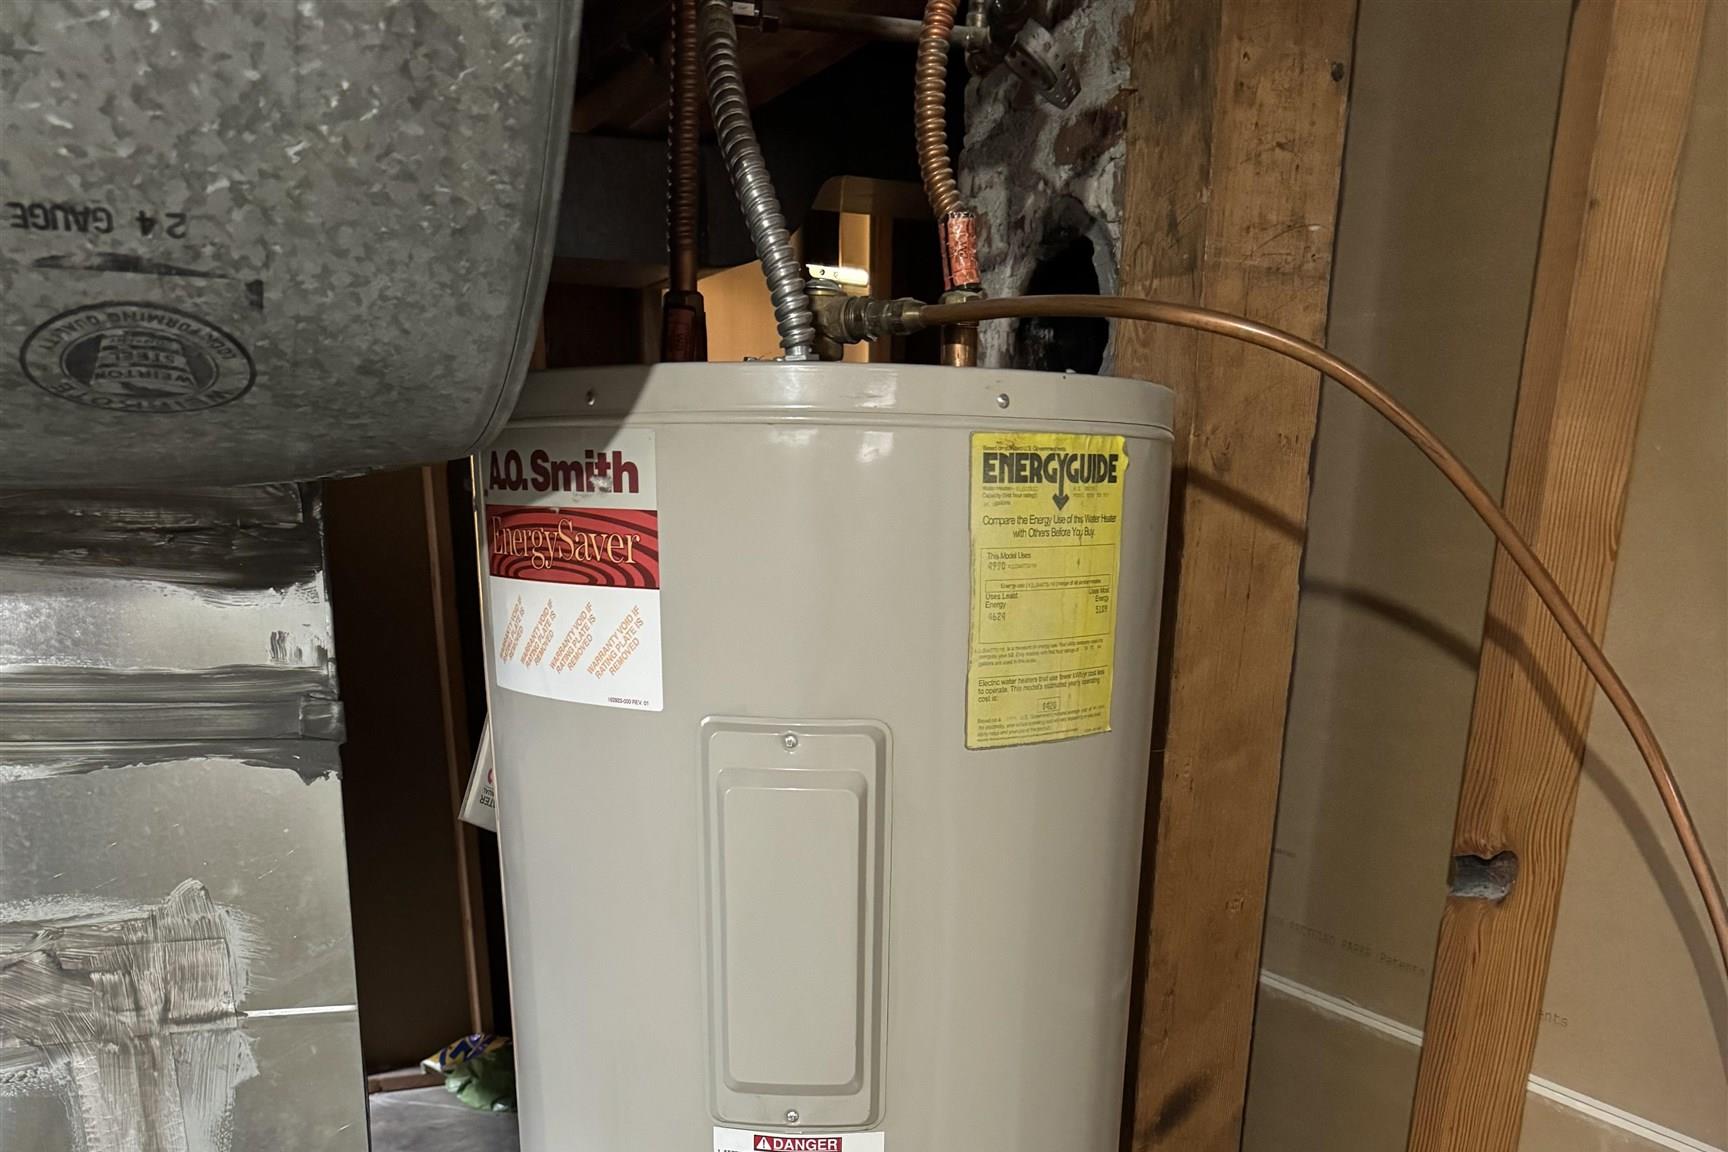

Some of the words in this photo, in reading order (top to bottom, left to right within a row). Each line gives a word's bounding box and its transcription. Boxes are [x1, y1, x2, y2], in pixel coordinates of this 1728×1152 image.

[6, 202, 114, 234] GAUGE
[135, 210, 188, 239] 24
[109, 351, 175, 364] STEEL
[982, 452, 1118, 484] ENERGYGUIDE
[983, 516, 1015, 527] Compare
[1017, 515, 1027, 524] the
[1029, 515, 1052, 527] Energy
[1053, 515, 1065, 524] Use
[1067, 514, 1073, 524] of
[1028, 528, 1049, 537] Others
[1051, 528, 1070, 536] Before
[1072, 527, 1083, 537] You
[491, 516, 640, 569] EnergySaver
[985, 601, 1006, 609] Energy
[549, 628, 576, 669] WARRANTY
[573, 611, 587, 630] VOID
[585, 601, 592, 612] IF
[556, 646, 574, 673] RATING
[572, 623, 591, 648] PLATE
[588, 614, 596, 625] IS
[587, 632, 618, 674] WARRANTY
[617, 614, 634, 634] VOID
[632, 605, 640, 617] IF
[595, 650, 618, 679] RATING
[615, 626, 637, 651] PLATE
[634, 618, 644, 629] IS
[567, 634, 592, 671] REMOVED
[608, 638, 639, 675] REMOVED
[773, 1138, 838, 1151] DANGER
